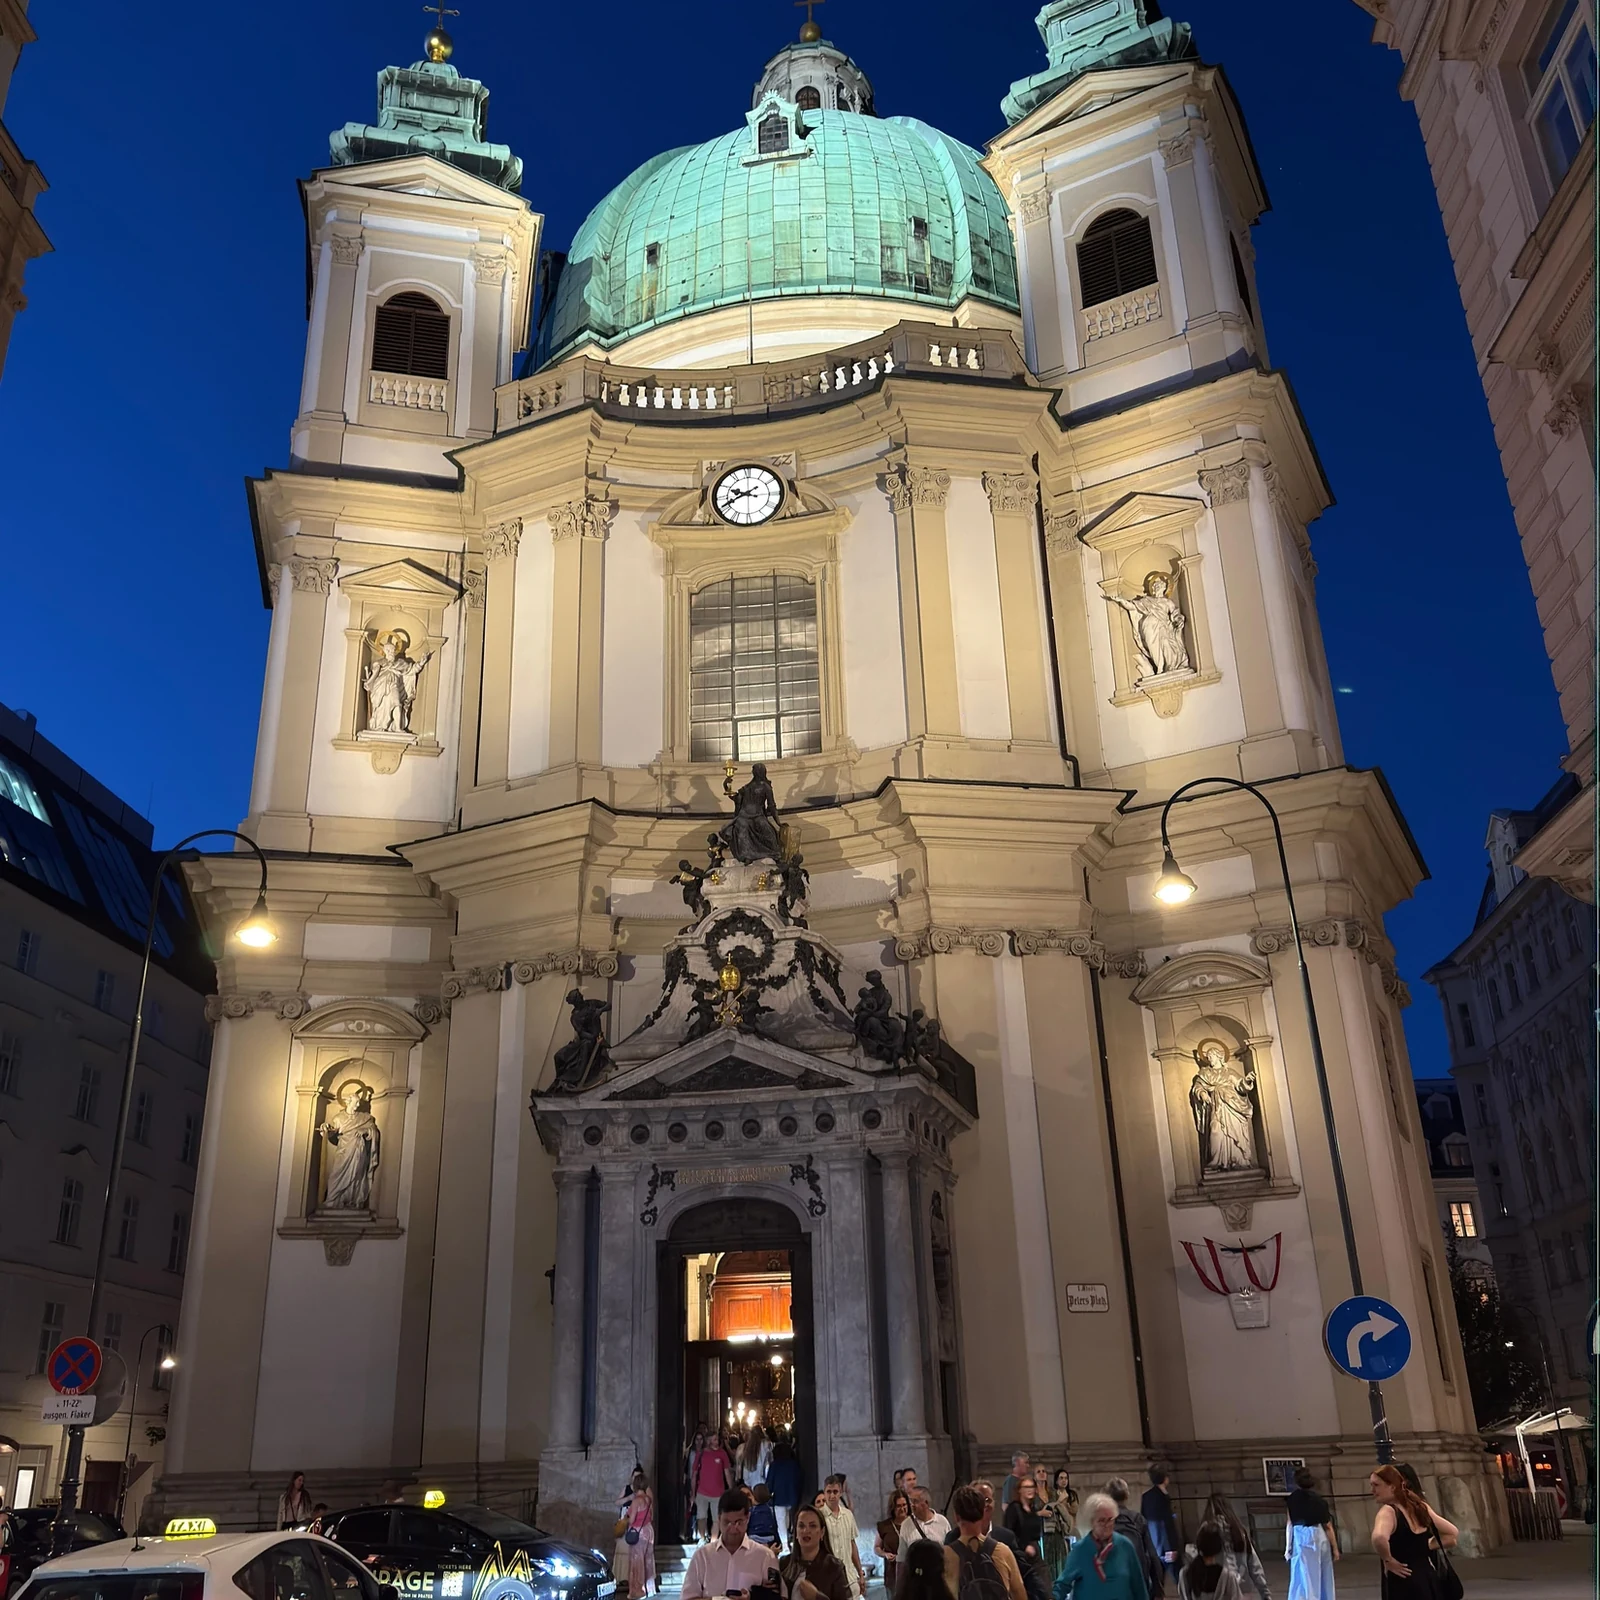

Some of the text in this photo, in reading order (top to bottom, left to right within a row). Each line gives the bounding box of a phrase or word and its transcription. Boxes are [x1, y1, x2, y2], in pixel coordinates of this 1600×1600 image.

[60, 1386, 80, 1396] ENDE
[70, 1410, 92, 1419] Fiaker
[170, 1520, 207, 1533] TAXI
